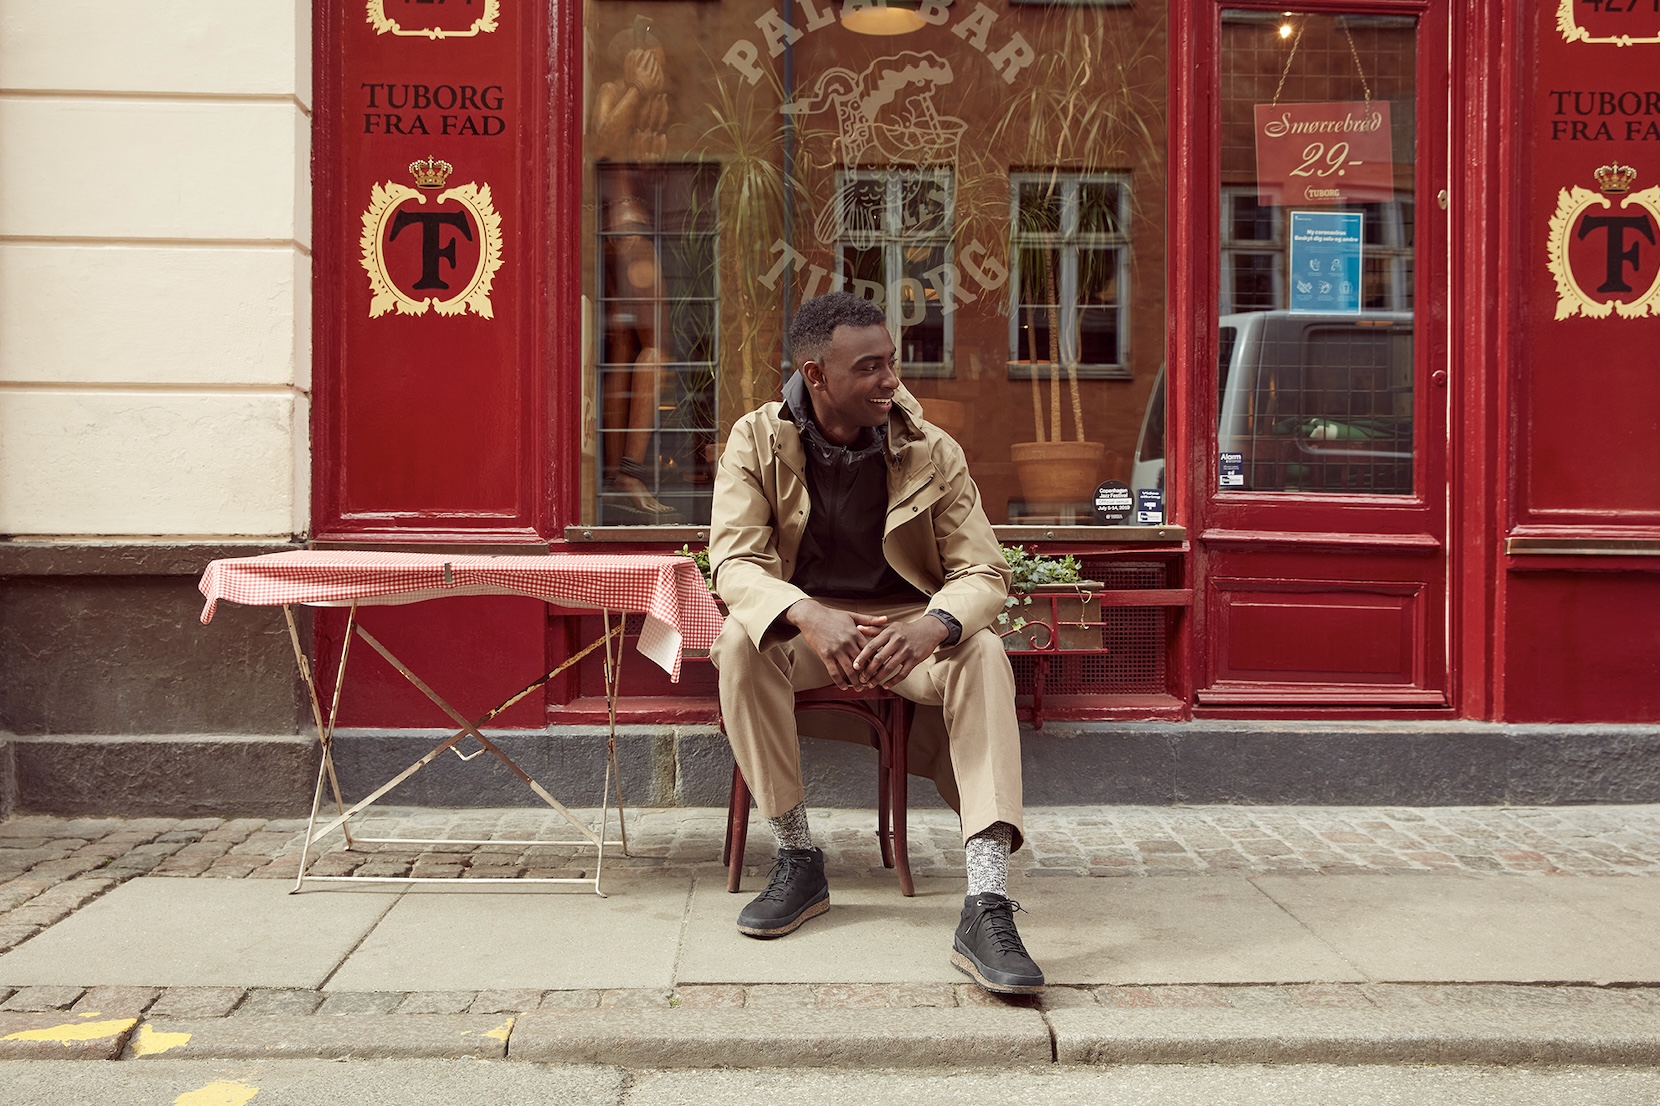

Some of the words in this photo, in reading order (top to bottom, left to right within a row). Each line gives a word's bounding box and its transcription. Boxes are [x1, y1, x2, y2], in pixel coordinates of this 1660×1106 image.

[916, 0, 1036, 85] BAR
[361, 83, 504, 111] TUBORG
[363, 113, 430, 135] FRA
[440, 115, 506, 136] FAD
[1264, 112, 1382, 138] Smørrebrød
[1551, 121, 1615, 141] FRA
[1289, 142, 1363, 177] 29.-
[1308, 189, 1340, 198] TUBORG
[1221, 453, 1242, 461] Alarm
